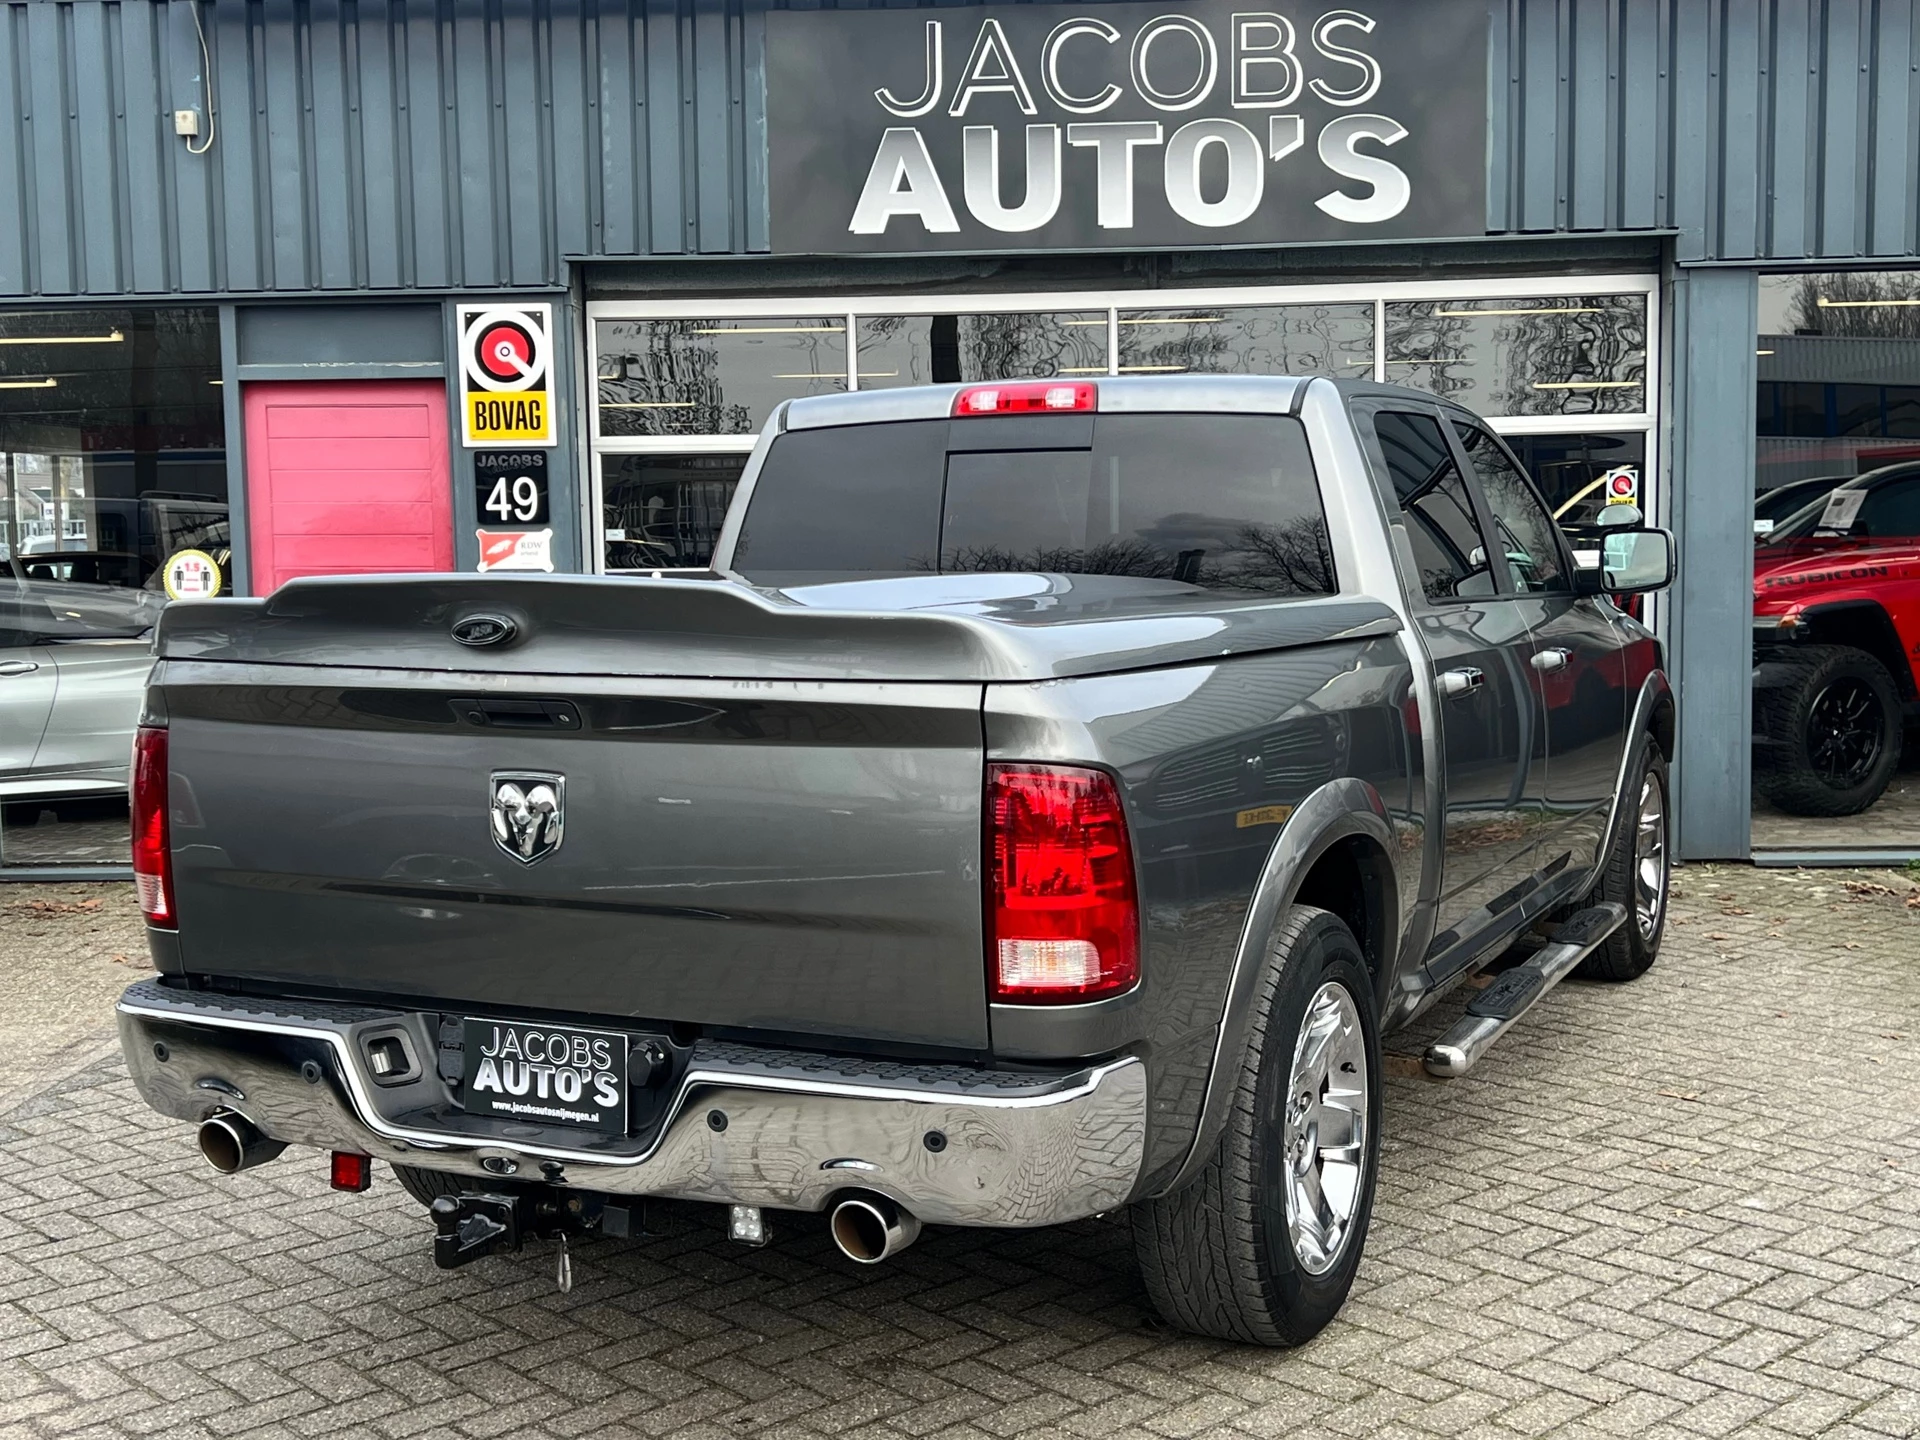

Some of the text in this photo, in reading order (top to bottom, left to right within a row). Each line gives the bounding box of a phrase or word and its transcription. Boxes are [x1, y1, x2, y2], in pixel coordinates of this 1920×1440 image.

[873, 8, 1382, 118] JACOBS
[848, 113, 1411, 234] AUTO'S
[474, 400, 541, 431] BOVAG
[476, 454, 544, 468] JACOBS
[485, 476, 538, 521] 49
[520, 541, 543, 549] RDW
[1765, 566, 1888, 588] RUBICON
[479, 1026, 612, 1070] JACOBS
[472, 1057, 620, 1108] AUTO'S
[492, 1100, 600, 1122] www.jacobsautosnijmegen.nl
